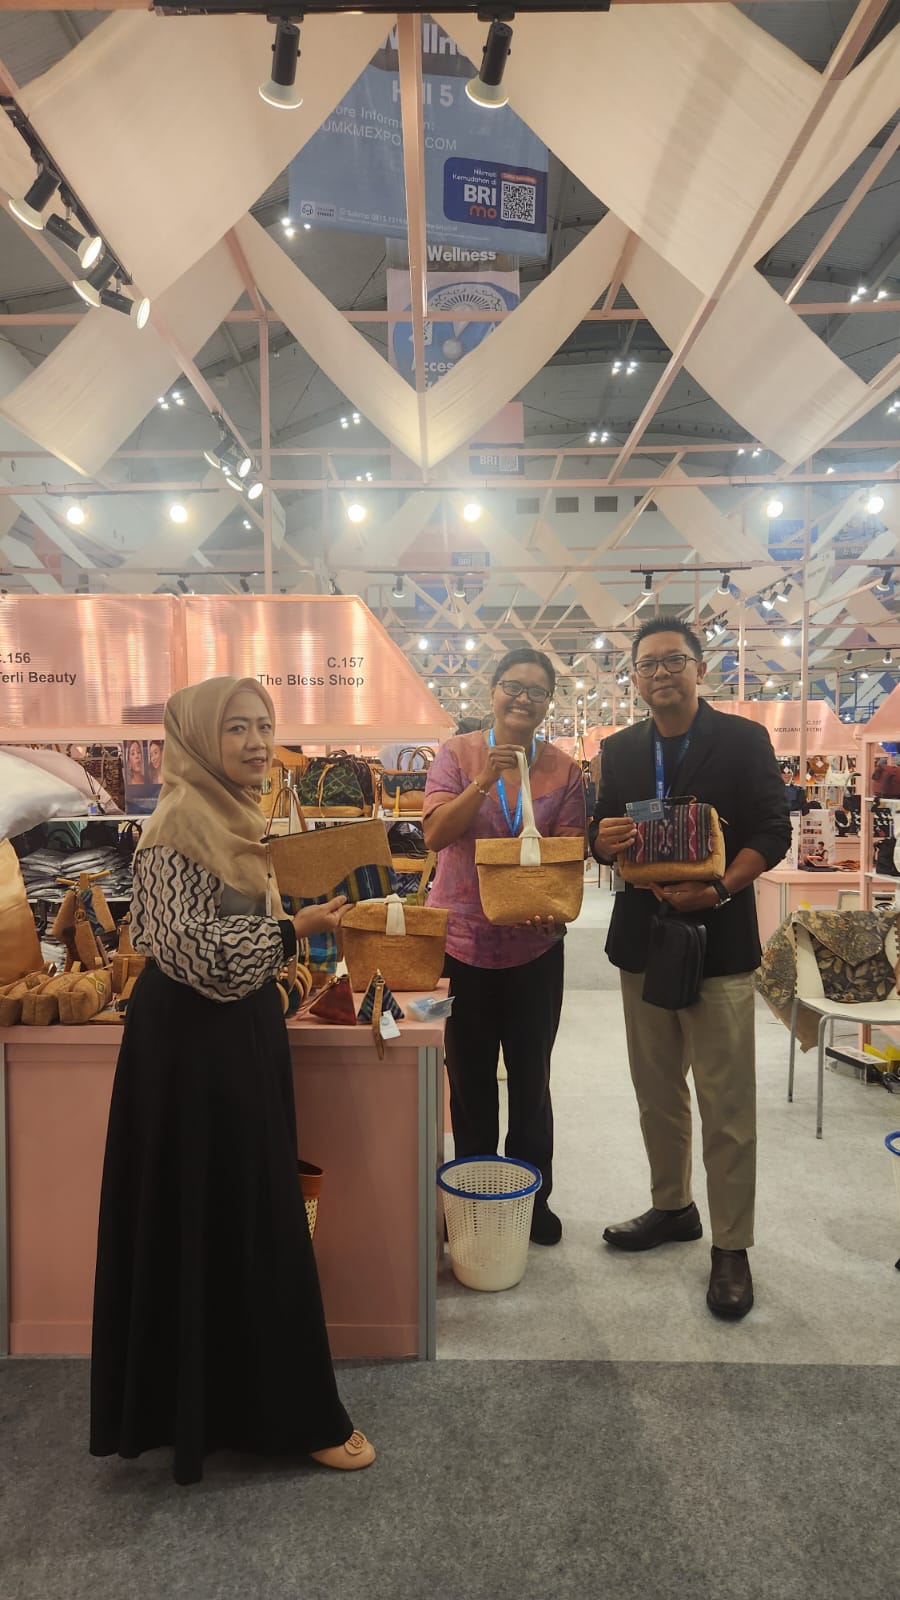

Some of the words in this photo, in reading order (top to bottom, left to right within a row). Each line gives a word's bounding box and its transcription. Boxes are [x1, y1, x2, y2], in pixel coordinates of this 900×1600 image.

[439, 84, 454, 107] 5
[463, 183, 497, 206] BRI
[469, 203, 497, 219] mo
[427, 244, 497, 262] Wellness
[480, 455, 497, 465] BRI
[0, 652, 31, 664] .156
[327, 656, 364, 668] C.157
[28, 671, 77, 686] Beauty
[257, 674, 283, 686] The
[287, 674, 325, 686] Bless
[329, 673, 364, 688] Shop
